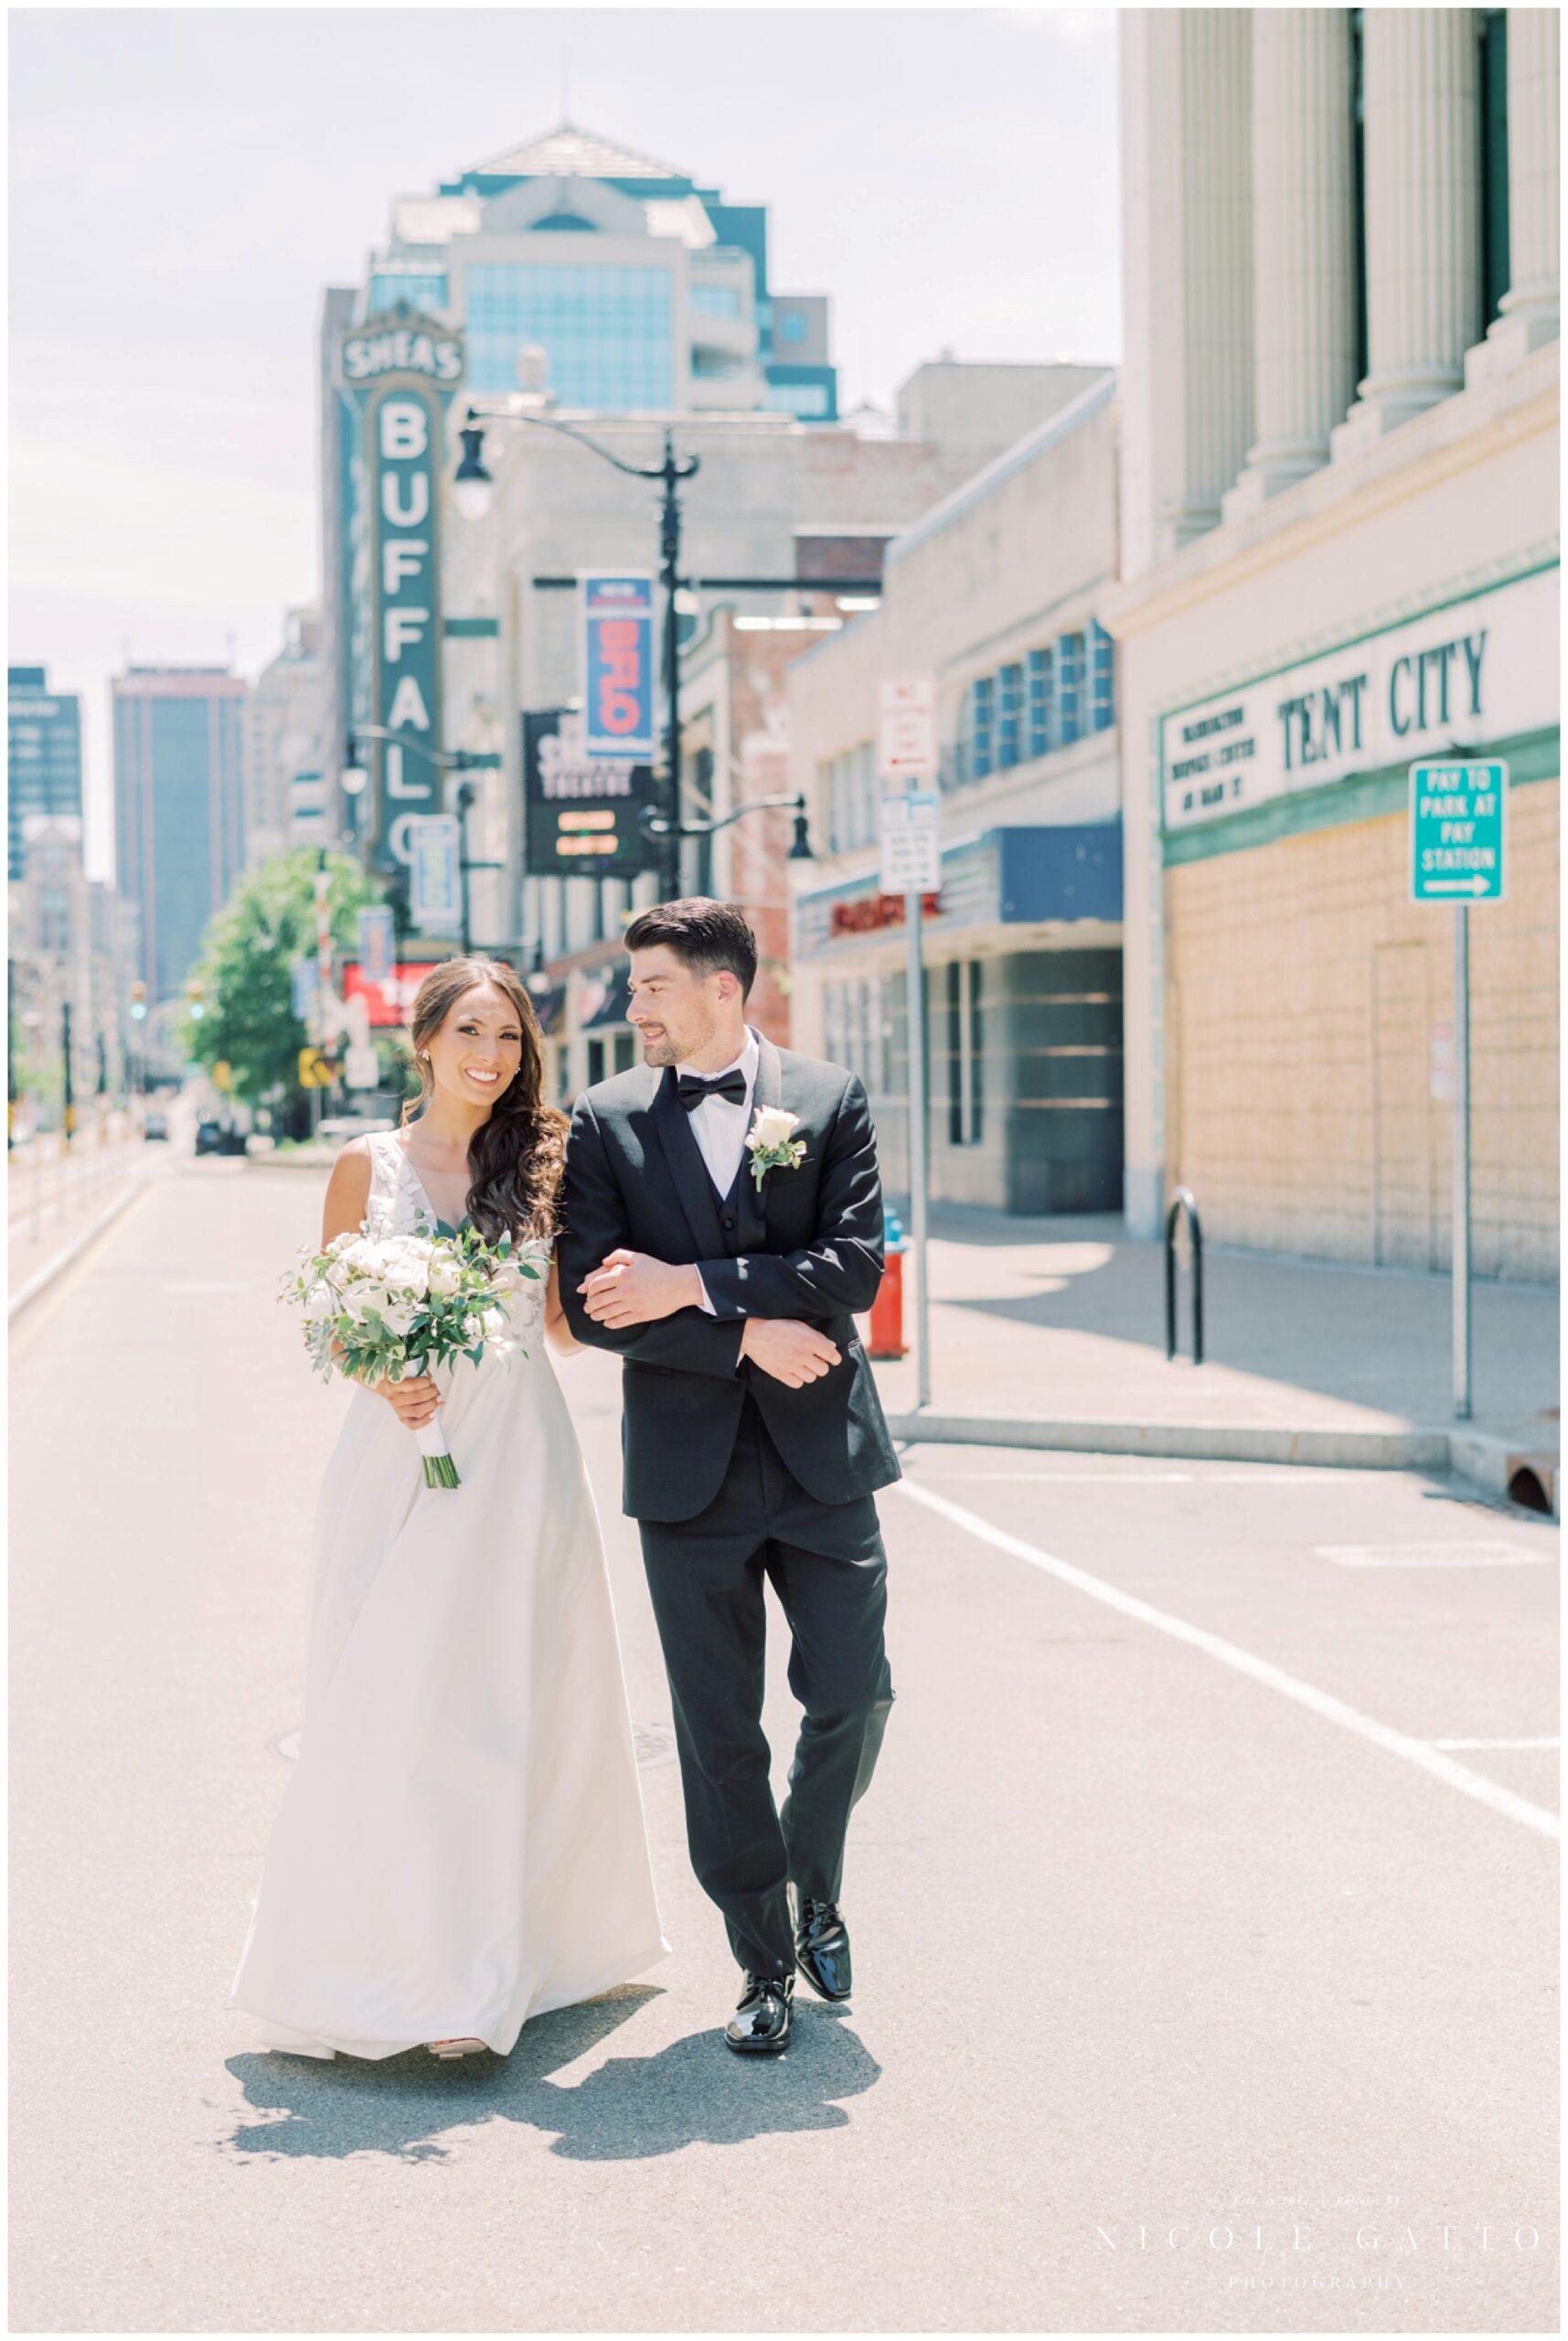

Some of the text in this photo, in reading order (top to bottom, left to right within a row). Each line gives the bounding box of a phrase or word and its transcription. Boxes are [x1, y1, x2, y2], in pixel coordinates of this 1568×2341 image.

[599, 620, 640, 734] BFLO
[1276, 628, 1488, 771] TENT CITY
[1427, 767, 1490, 791] PAY TO
[1421, 793, 1497, 818] PARK AT
[1441, 820, 1475, 843] PAY
[1422, 848, 1496, 871] STATION
